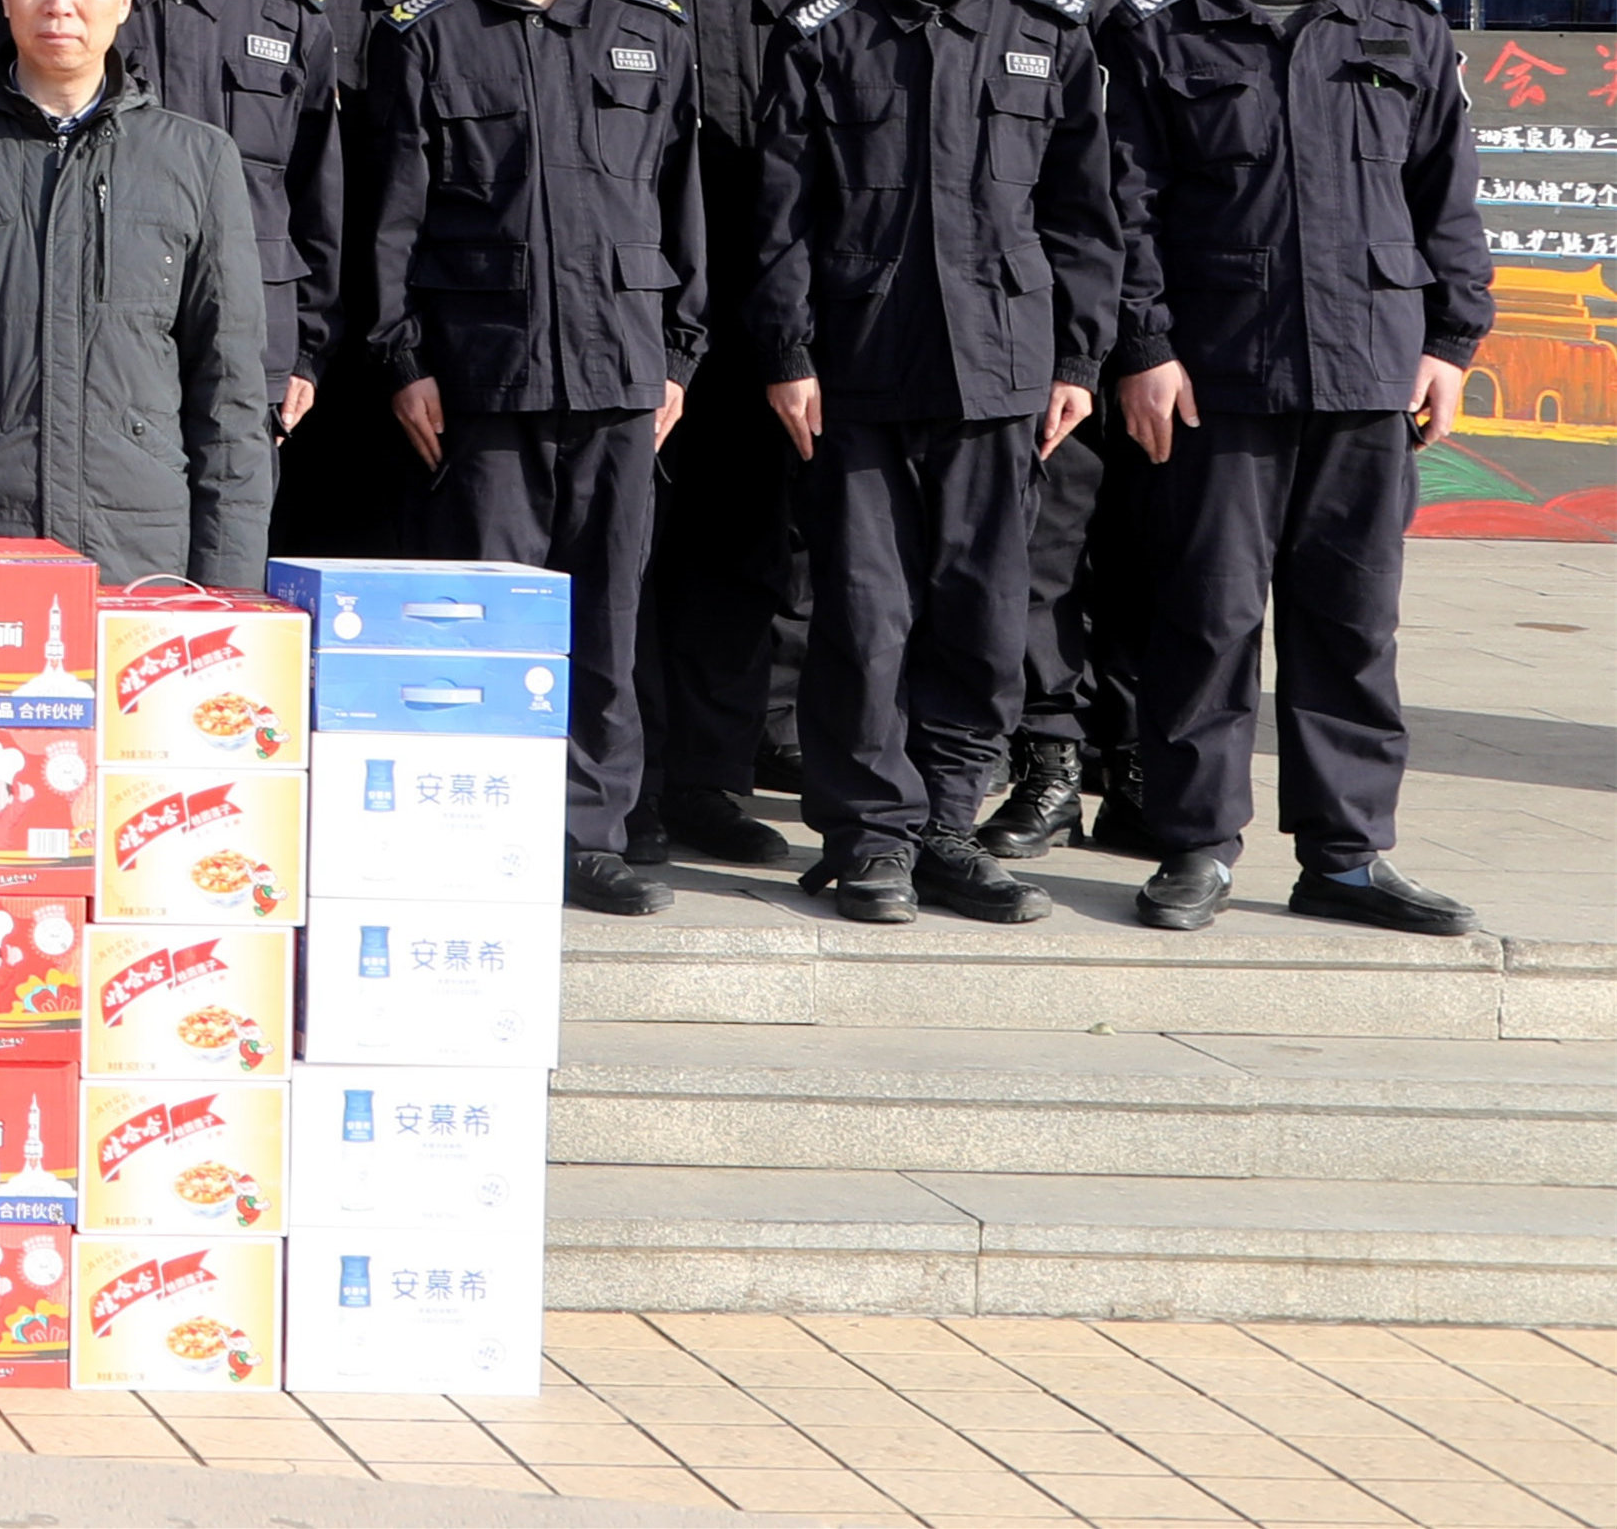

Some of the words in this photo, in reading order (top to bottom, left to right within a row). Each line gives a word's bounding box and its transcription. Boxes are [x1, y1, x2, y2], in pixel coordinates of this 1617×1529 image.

[414, 773, 513, 807] 安慕希
[408, 939, 507, 973] 安慕希
[393, 1103, 492, 1137] 安慕希
[390, 1268, 489, 1302] 安慕希
